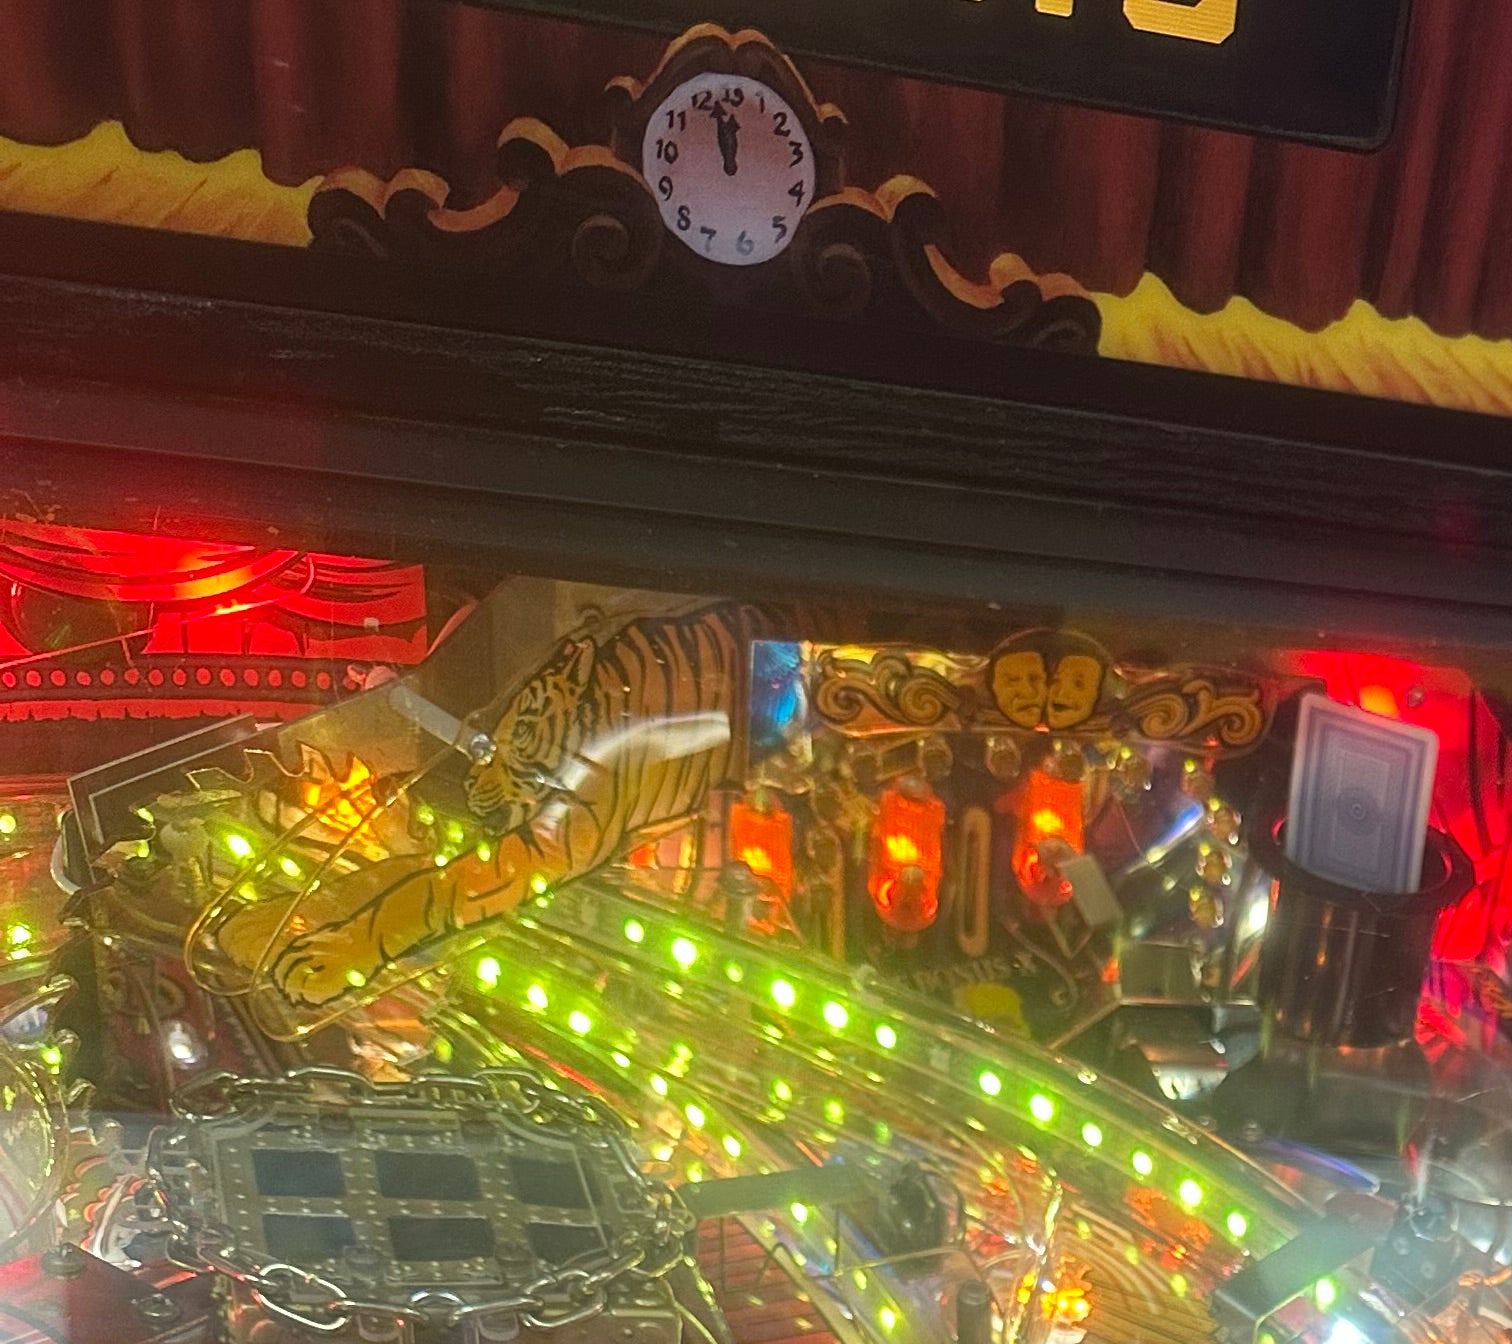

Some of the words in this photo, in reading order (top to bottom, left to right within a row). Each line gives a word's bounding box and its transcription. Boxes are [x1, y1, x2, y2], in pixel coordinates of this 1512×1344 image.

[691, 90, 713, 111] 12
[755, 91, 766, 114] 1
[666, 110, 687, 132] 11
[773, 112, 791, 137] 2
[655, 139, 679, 165] 10
[788, 141, 804, 169] 3
[658, 176, 674, 201] 9
[788, 180, 805, 208] 4
[677, 205, 691, 232] 8
[772, 216, 788, 244] 5
[700, 227, 716, 253] 7
[735, 231, 755, 256] 6
